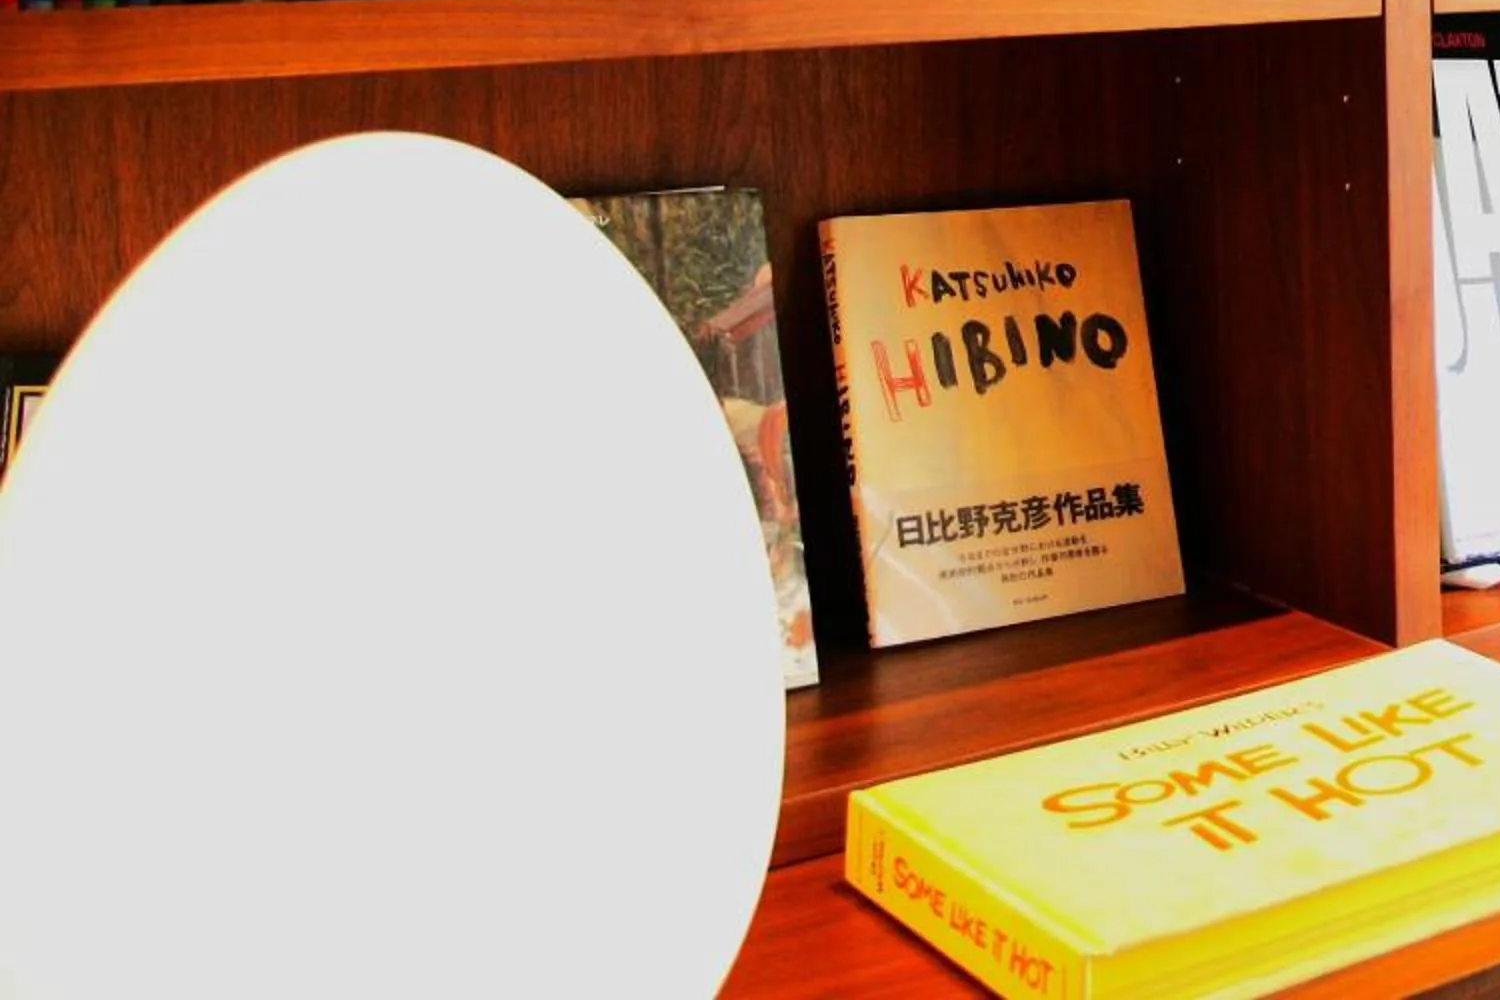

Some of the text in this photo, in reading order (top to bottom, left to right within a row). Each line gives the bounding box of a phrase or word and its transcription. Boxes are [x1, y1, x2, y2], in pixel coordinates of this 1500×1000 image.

[871, 311, 1129, 422] HIBINO
[895, 483, 1145, 549] 日比野克彦作品集
[1042, 688, 1476, 829] SOME LIKE
[1161, 733, 1486, 852] IT HOT
[894, 857, 946, 919] SOME
[950, 902, 987, 949] LIKE
[1009, 940, 1054, 995] HOT
